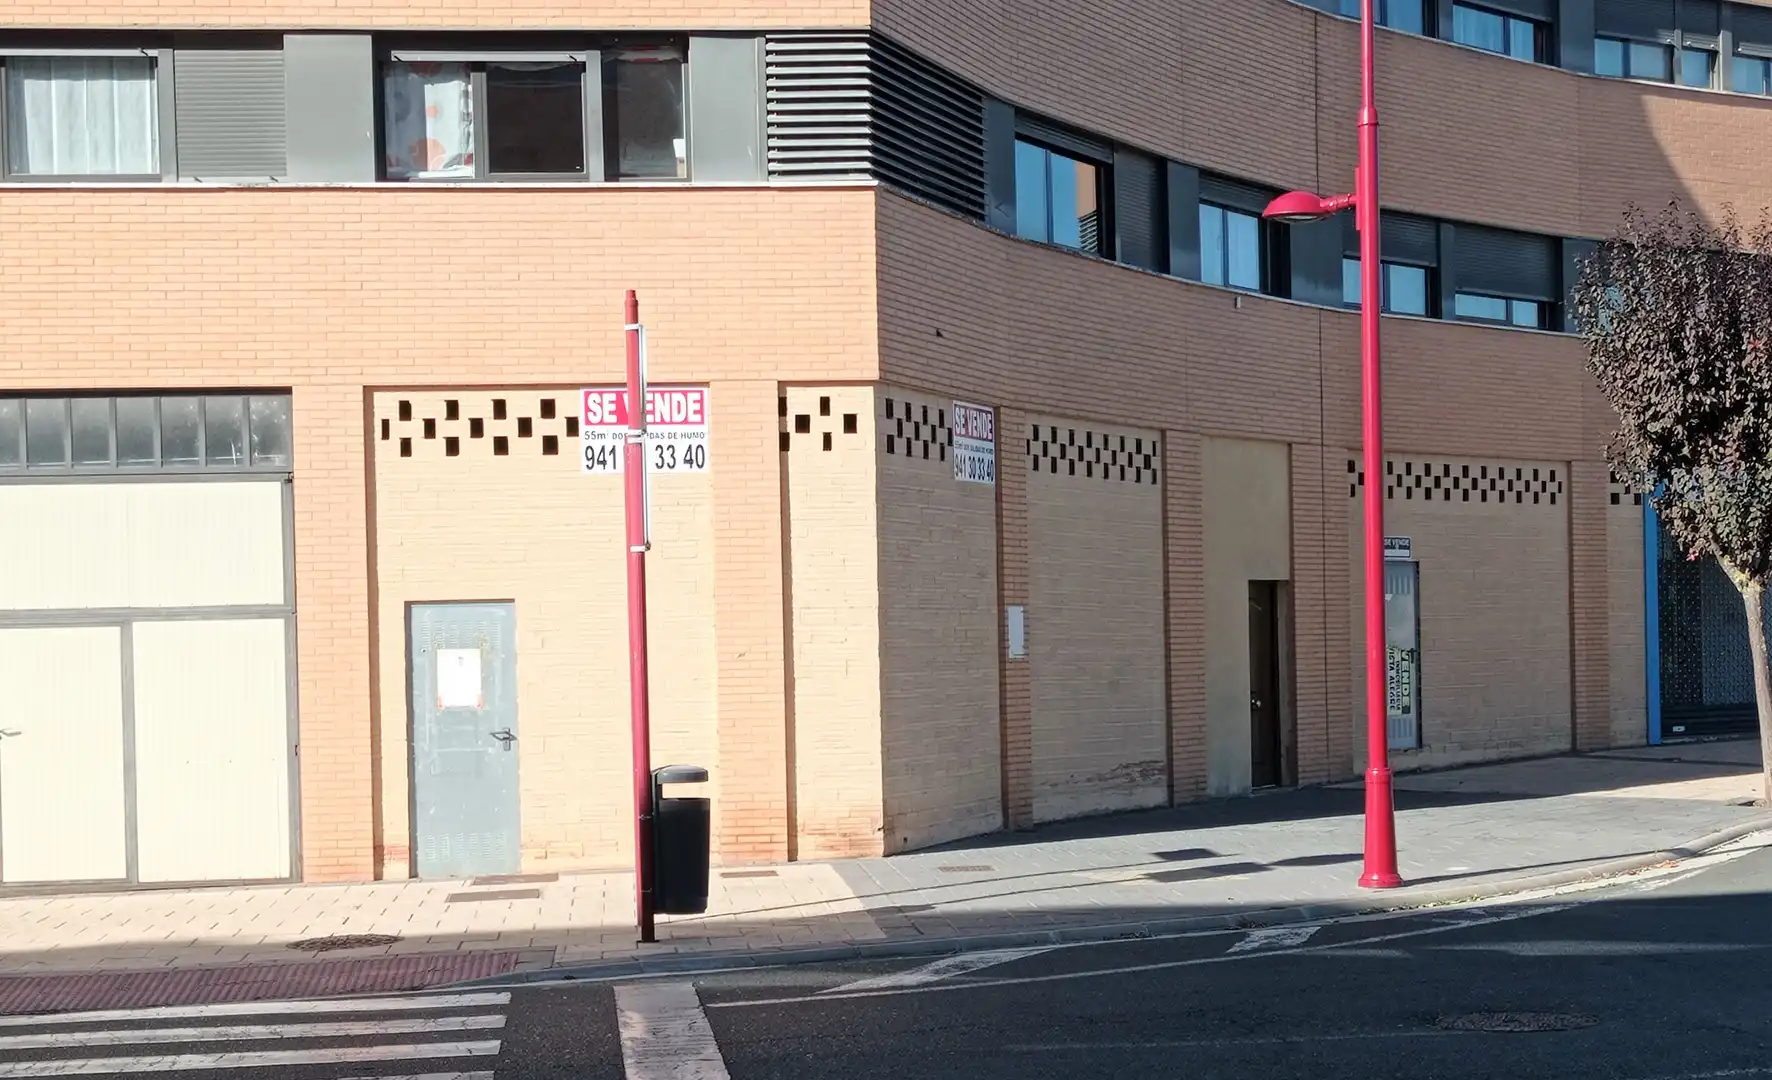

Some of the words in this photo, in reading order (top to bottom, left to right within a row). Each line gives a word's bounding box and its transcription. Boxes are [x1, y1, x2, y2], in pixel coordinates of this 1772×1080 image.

[587, 392, 618, 424] SE
[955, 406, 966, 435] SE
[966, 408, 993, 440] VENDE
[667, 431, 678, 440] DE
[680, 431, 706, 440] HUMO
[584, 444, 617, 470] 941
[655, 444, 677, 469] 33
[683, 444, 706, 469] 40
[954, 453, 967, 479] 941
[968, 455, 977, 480] 30
[986, 459, 995, 482] 40
[1401, 650, 1410, 707] VENDE
